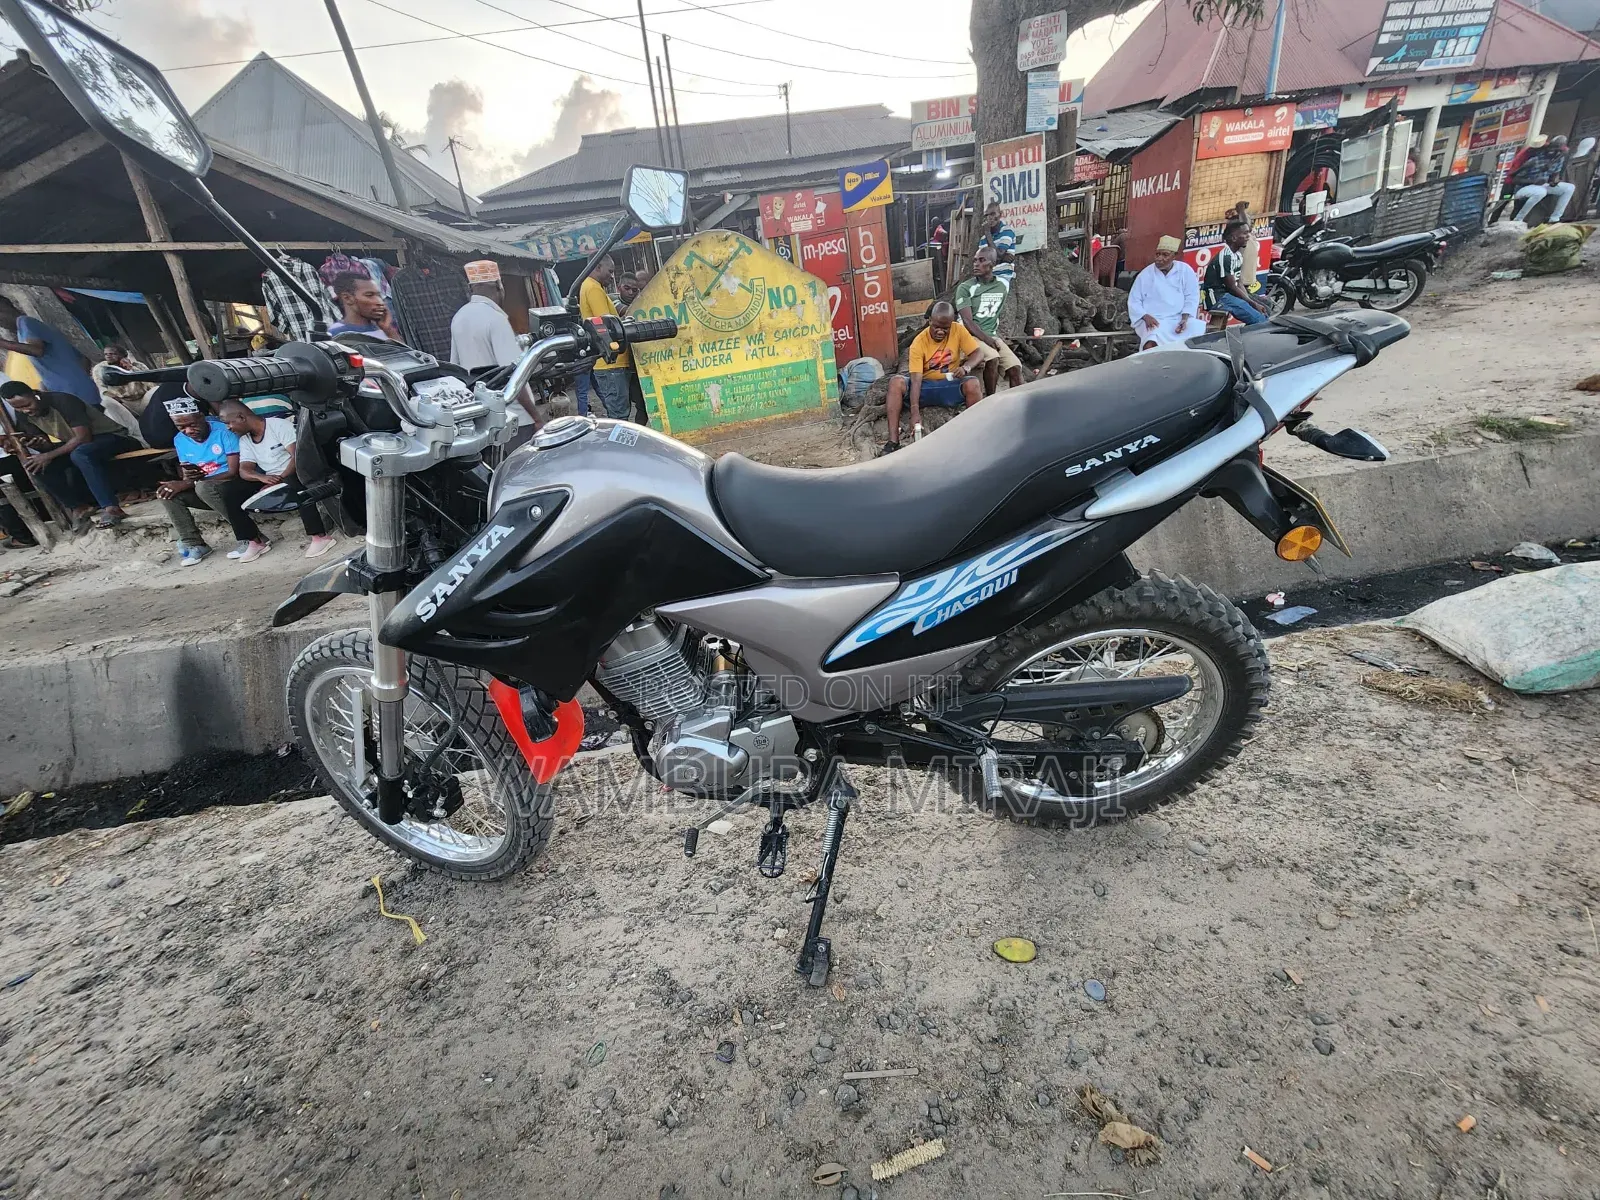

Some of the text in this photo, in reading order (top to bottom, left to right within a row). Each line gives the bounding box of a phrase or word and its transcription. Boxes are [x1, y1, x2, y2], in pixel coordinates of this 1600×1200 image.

[1028, 14, 1061, 30] AGENTI
[1422, 15, 1445, 28] SIMU
[1442, 14, 1455, 27] ZA
[1453, 11, 1492, 26] SAMSUNG
[1031, 37, 1054, 49] YOTE
[927, 97, 960, 120] BIN
[1225, 119, 1265, 133] WAKALA
[1267, 125, 1290, 138] airtel
[847, 177, 859, 186] yas
[989, 168, 1040, 205] SIMU
[1132, 170, 1181, 199] WAKALA
[870, 194, 891, 203] Wakala
[787, 213, 815, 223] WAKALA
[1000, 202, 1045, 219] APATIKANA
[1254, 217, 1269, 229] ANA
[803, 237, 848, 261] m-pesa
[860, 301, 889, 321] pesa
[714, 319, 733, 330] CHA
[831, 325, 853, 342] tel
[639, 324, 822, 366] SHINA LA WAZEE WA SAIGON
[682, 353, 733, 372] BENDERA
[1064, 433, 1161, 479] SANYA
[414, 522, 515, 624] SANYA
[912, 568, 1019, 636] CHASQUI
